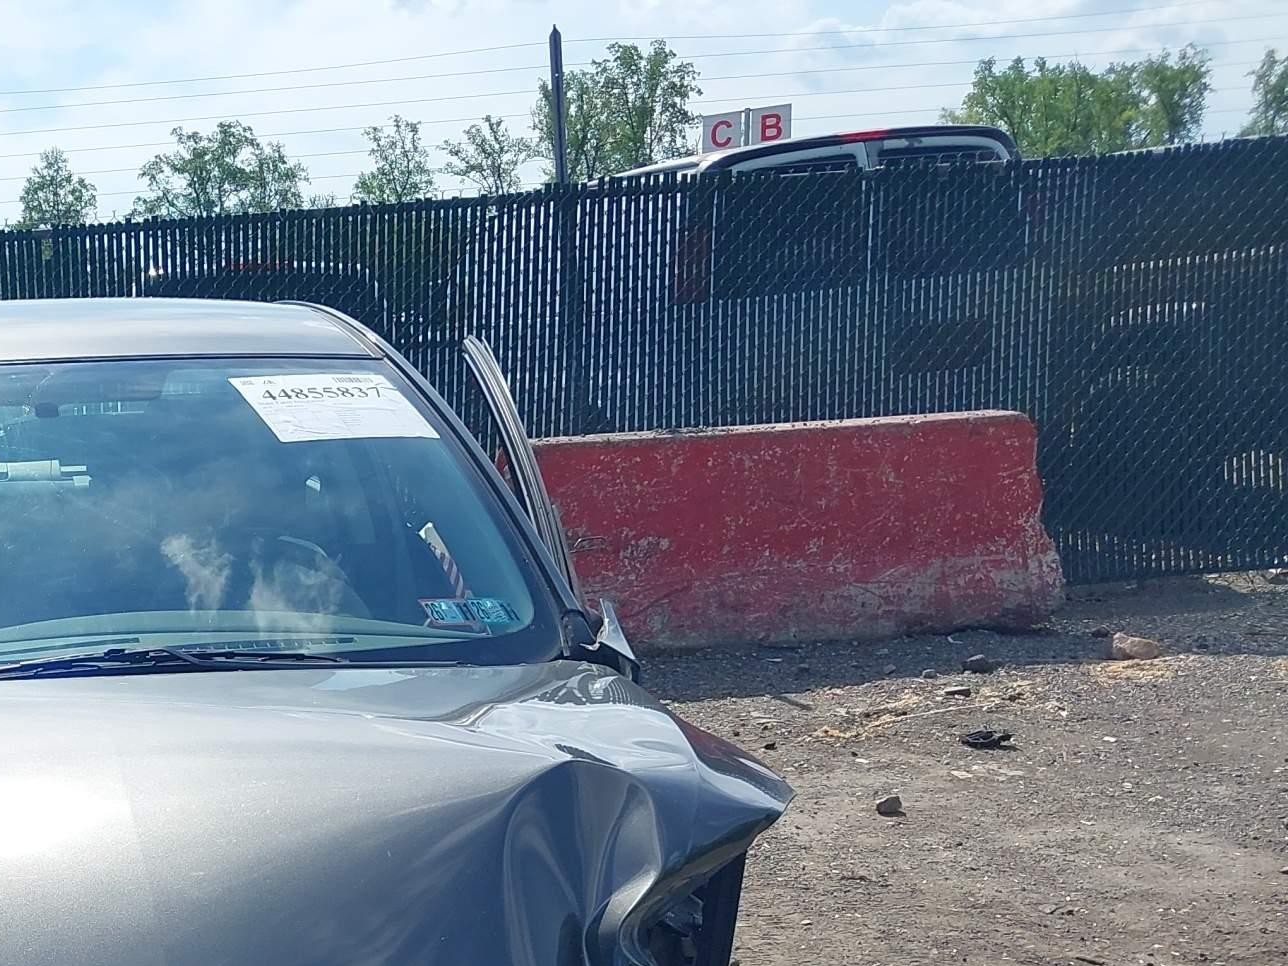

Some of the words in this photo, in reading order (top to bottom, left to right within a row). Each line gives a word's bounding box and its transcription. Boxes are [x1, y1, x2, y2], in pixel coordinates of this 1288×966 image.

[710, 119, 733, 148] C
[760, 113, 783, 142] B
[262, 385, 382, 402] 44855837
[424, 602, 445, 621] 26
